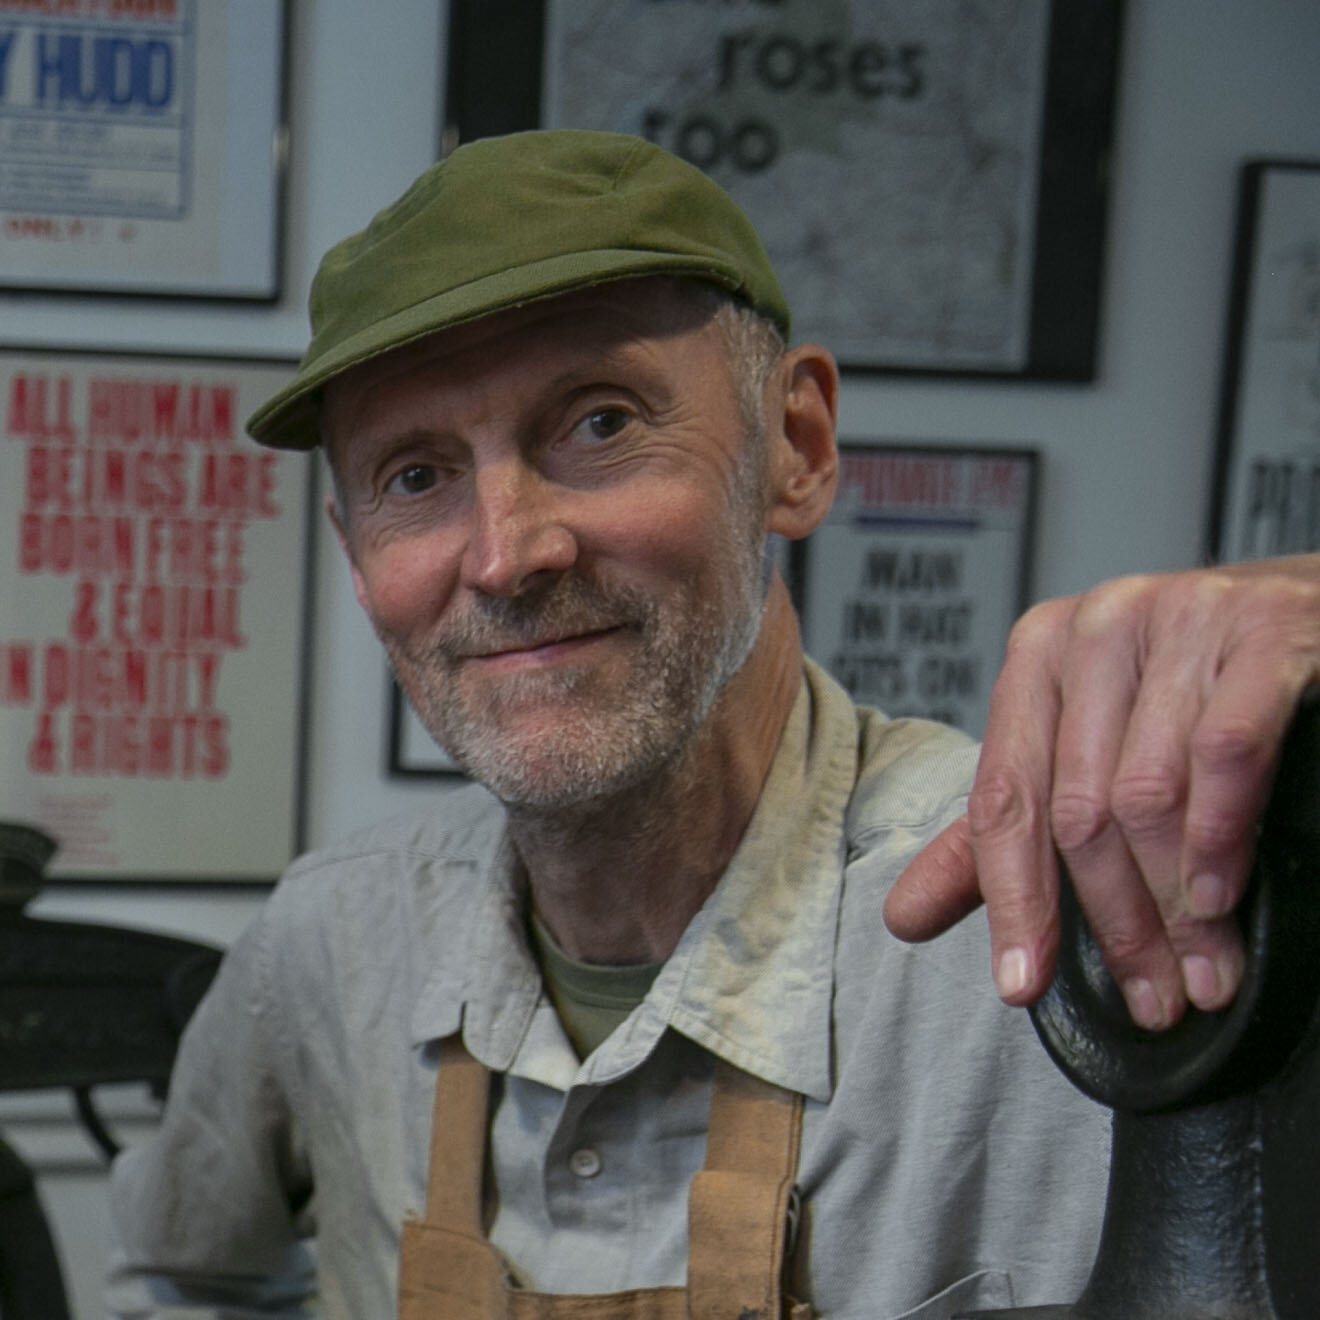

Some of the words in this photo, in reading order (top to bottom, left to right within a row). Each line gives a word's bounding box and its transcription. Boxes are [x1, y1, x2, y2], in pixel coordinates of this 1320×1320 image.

[36, 33, 176, 116] HUDD
[715, 27, 928, 101] roses
[6, 374, 75, 441] ALL
[87, 379, 237, 443] HUMAN
[26, 445, 187, 512] BEINGS
[199, 450, 282, 519] ARE
[18, 513, 134, 577] BORN
[145, 516, 248, 585] FREE
[69, 581, 99, 643] &
[112, 583, 248, 650] EQUAL
[42, 643, 221, 712] DIGNITY
[27, 714, 58, 776] &
[68, 714, 231, 780] RIGHTS
